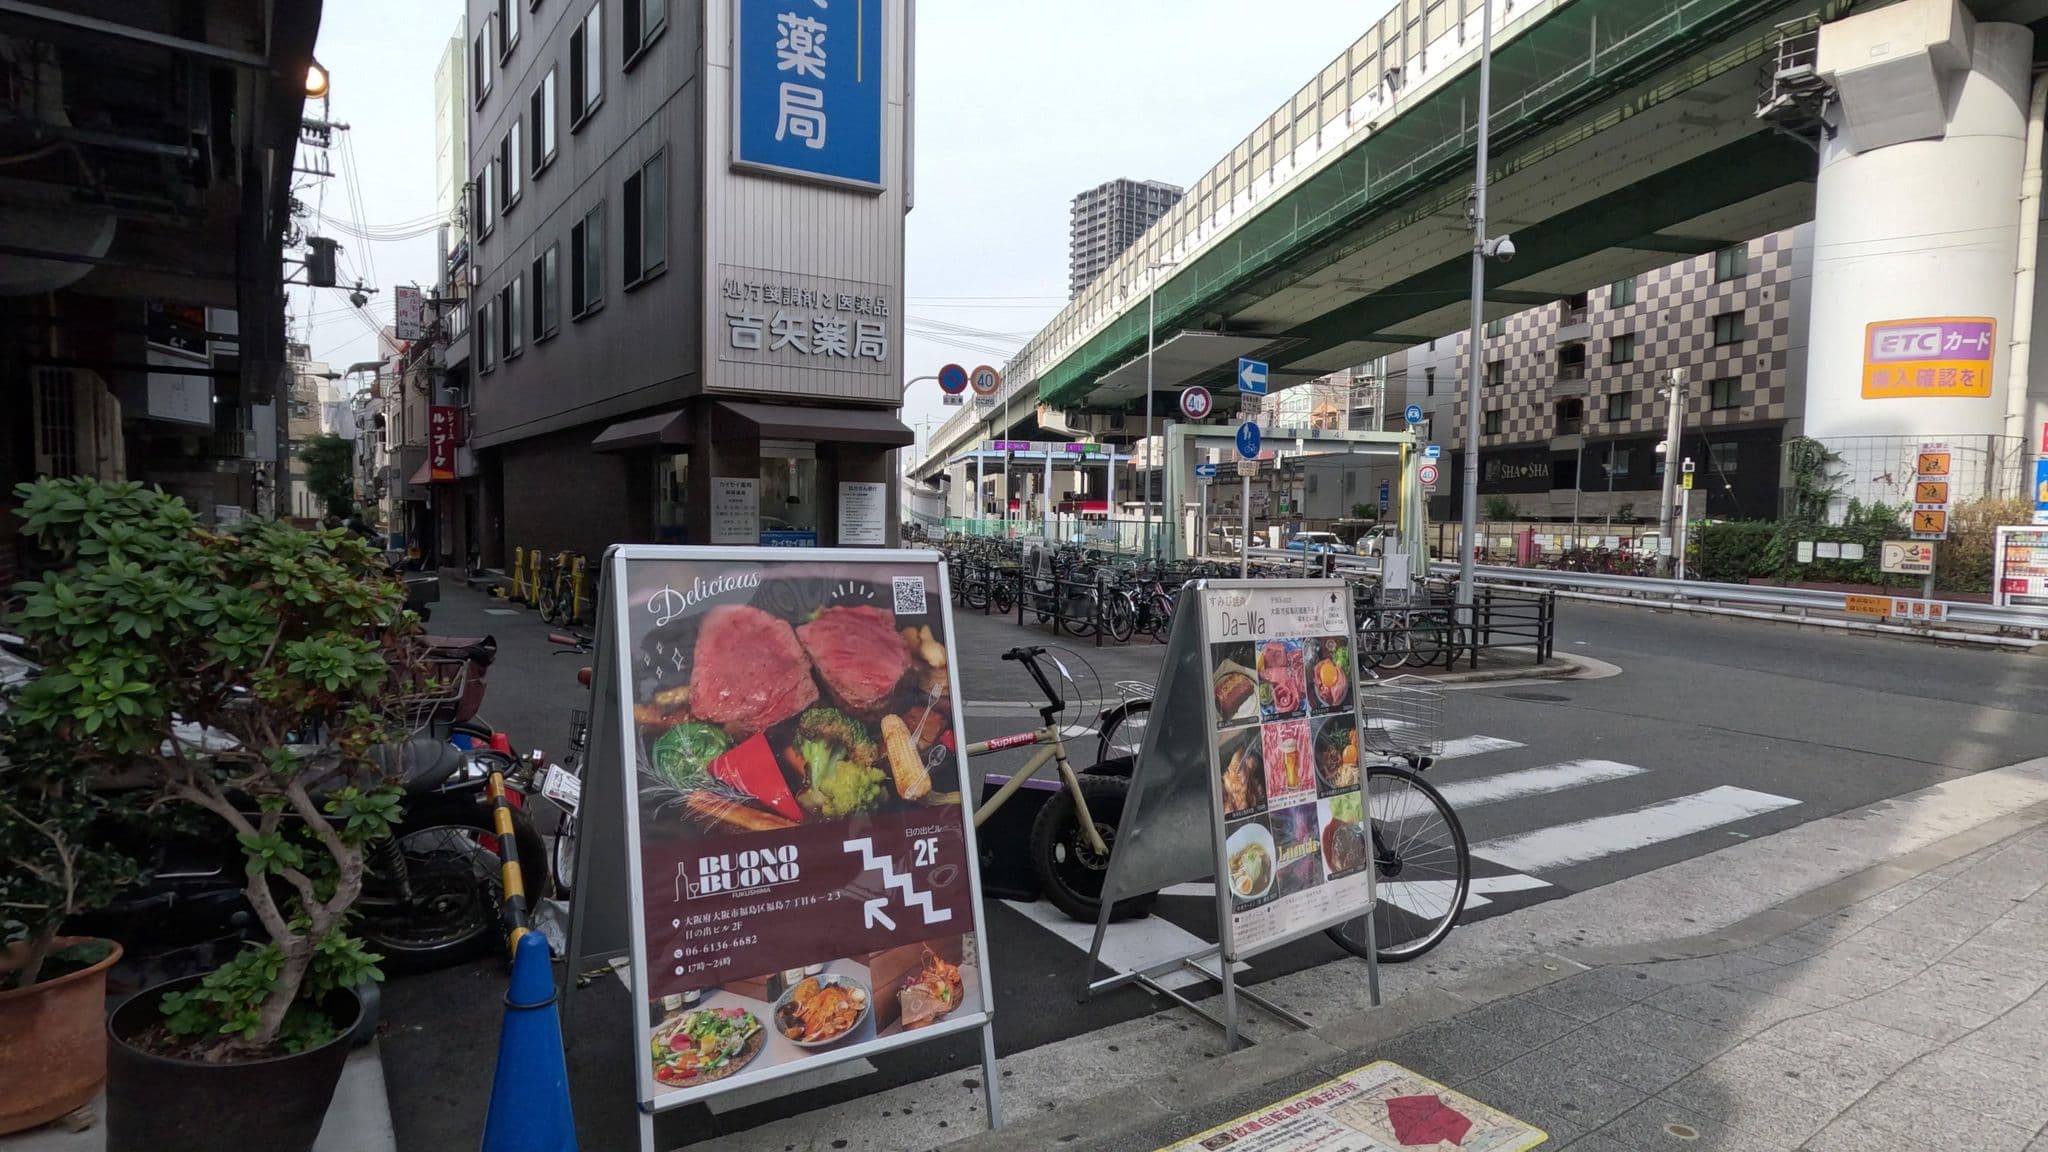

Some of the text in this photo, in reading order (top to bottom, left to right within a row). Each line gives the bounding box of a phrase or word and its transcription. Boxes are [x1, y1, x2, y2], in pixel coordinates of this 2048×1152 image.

[774, 0, 829, 150] 薬局
[722, 278, 890, 318] 処方箋調剤と医薬品
[725, 308, 889, 362] 吉矢薬局
[1881, 330, 1991, 353] ETC カード
[977, 374, 993, 388] 40
[1501, 464, 1520, 479] SHA
[1528, 462, 1549, 478] SHA
[647, 571, 761, 627] Delicious
[1221, 610, 1266, 636] Da-Wa
[990, 732, 1034, 749] Supreme
[905, 824, 943, 837] 日の出ビル
[699, 844, 799, 876] BUONO
[913, 837, 939, 867] 2F
[700, 862, 800, 894] BUONO
[731, 887, 771, 899] FUKUSHIMA
[685, 935, 758, 957] 06-6136-6682
